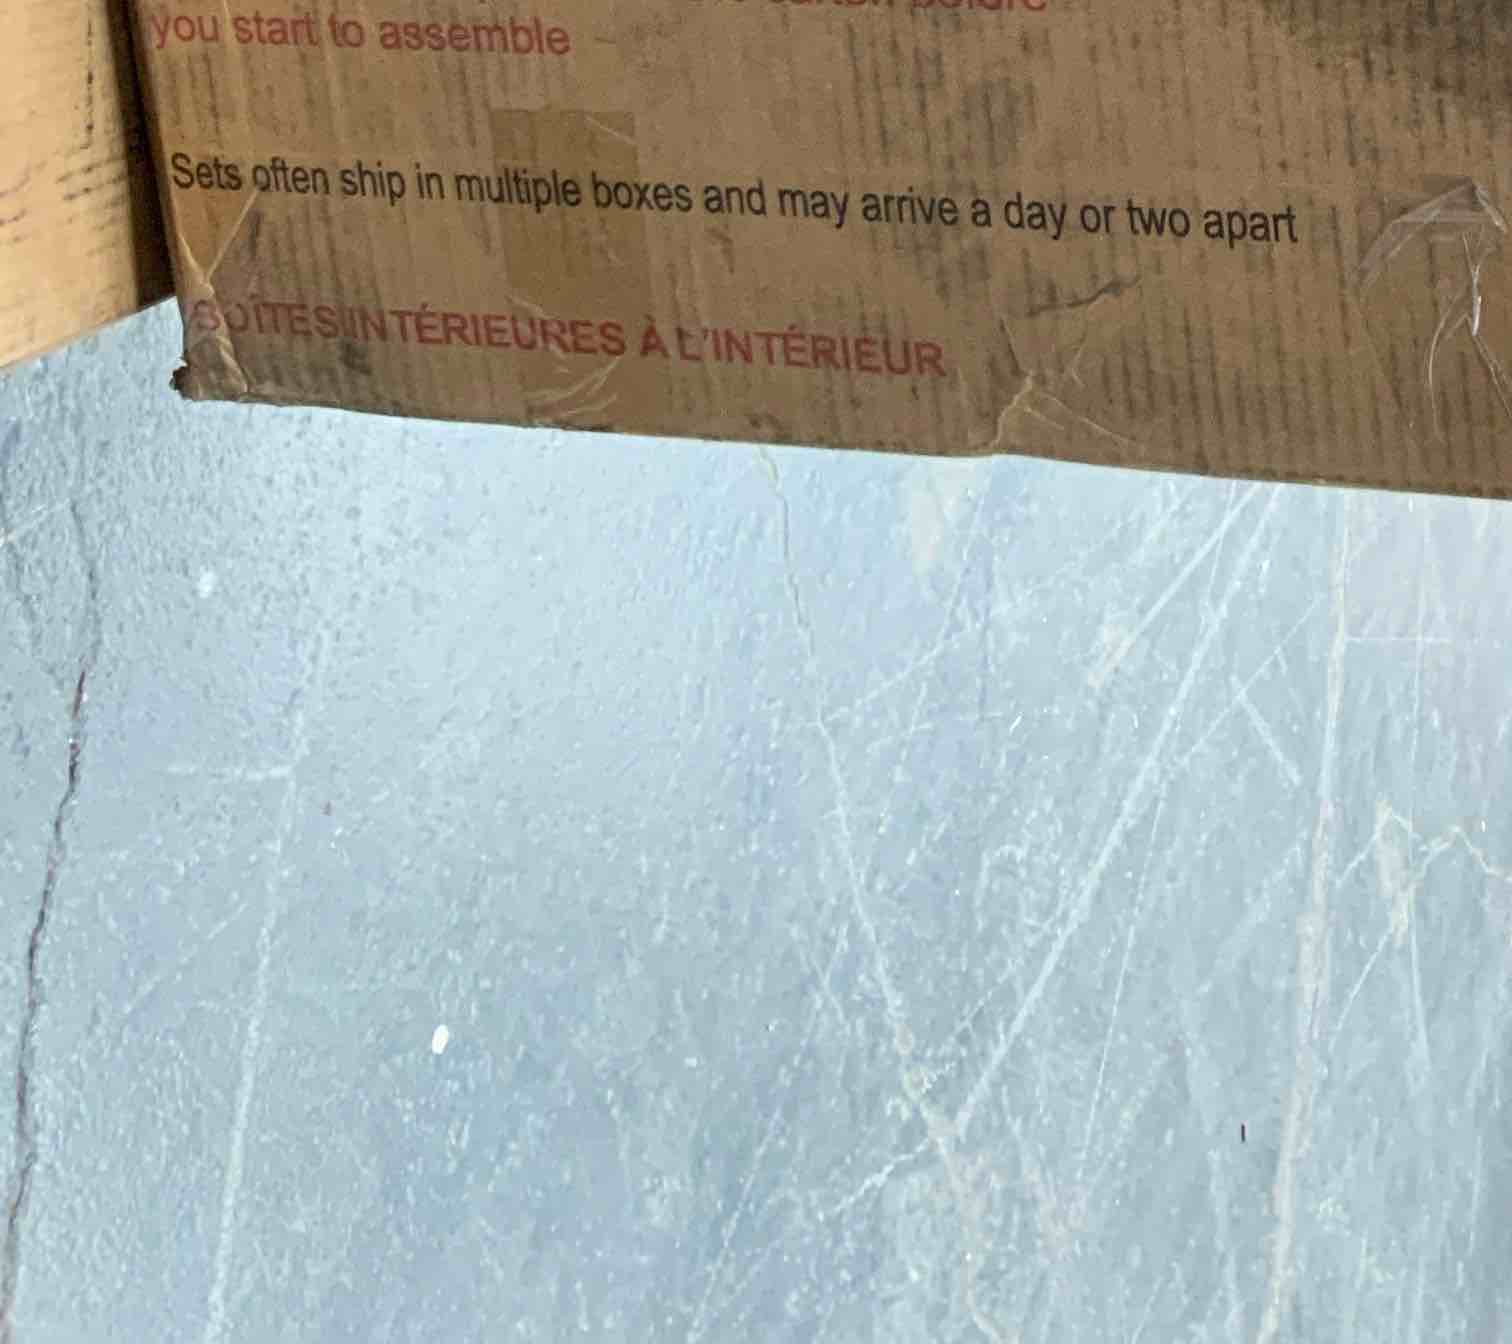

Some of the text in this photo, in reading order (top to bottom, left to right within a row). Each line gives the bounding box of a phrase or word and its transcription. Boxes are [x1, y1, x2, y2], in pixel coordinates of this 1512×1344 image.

[151, 11, 572, 56] you start to assemble
[171, 153, 1299, 249] Sets often ship in multiple boxes and may arrive a day or two apart
[349, 303, 627, 358] INTÉRIEURES
[640, 314, 670, 359] À
[676, 324, 948, 377] L'INTÉRIEUR
